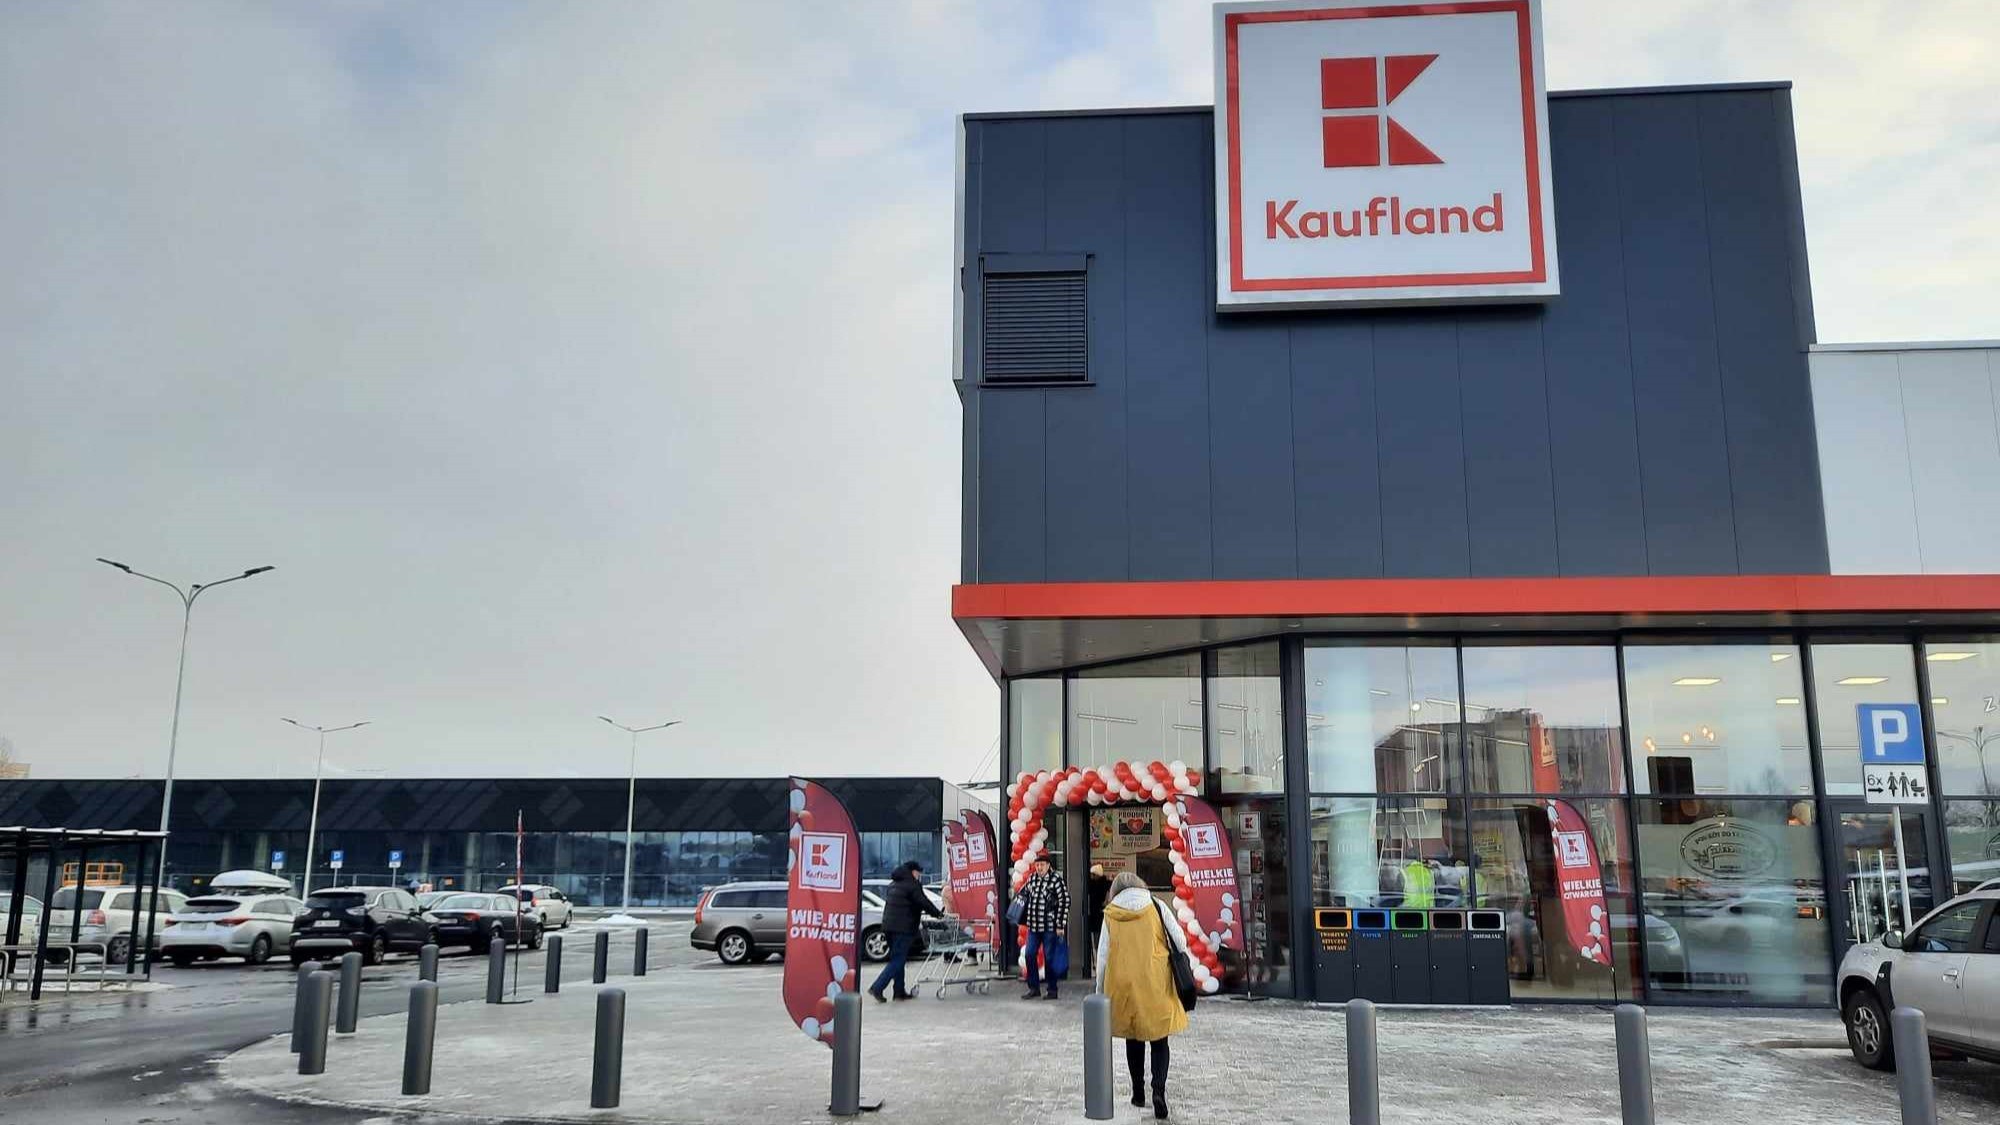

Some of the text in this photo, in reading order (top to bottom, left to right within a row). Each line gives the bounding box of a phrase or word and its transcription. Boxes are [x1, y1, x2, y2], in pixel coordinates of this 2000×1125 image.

[1266, 193, 1504, 239] Kaufland
[1871, 709, 1909, 756] P
[1867, 774, 1883, 786] 6x
[1197, 830, 1209, 844] K
[1567, 838, 1579, 852] K
[812, 844, 830, 867] K
[806, 870, 838, 880] Kaufland
[1191, 868, 1234, 880] WIELKIE
[1192, 878, 1235, 888] OTWARCIE!
[1563, 879, 1602, 891] WIELKIE
[791, 909, 855, 929] WIEKIE
[790, 927, 855, 944] OTWARCIE!
